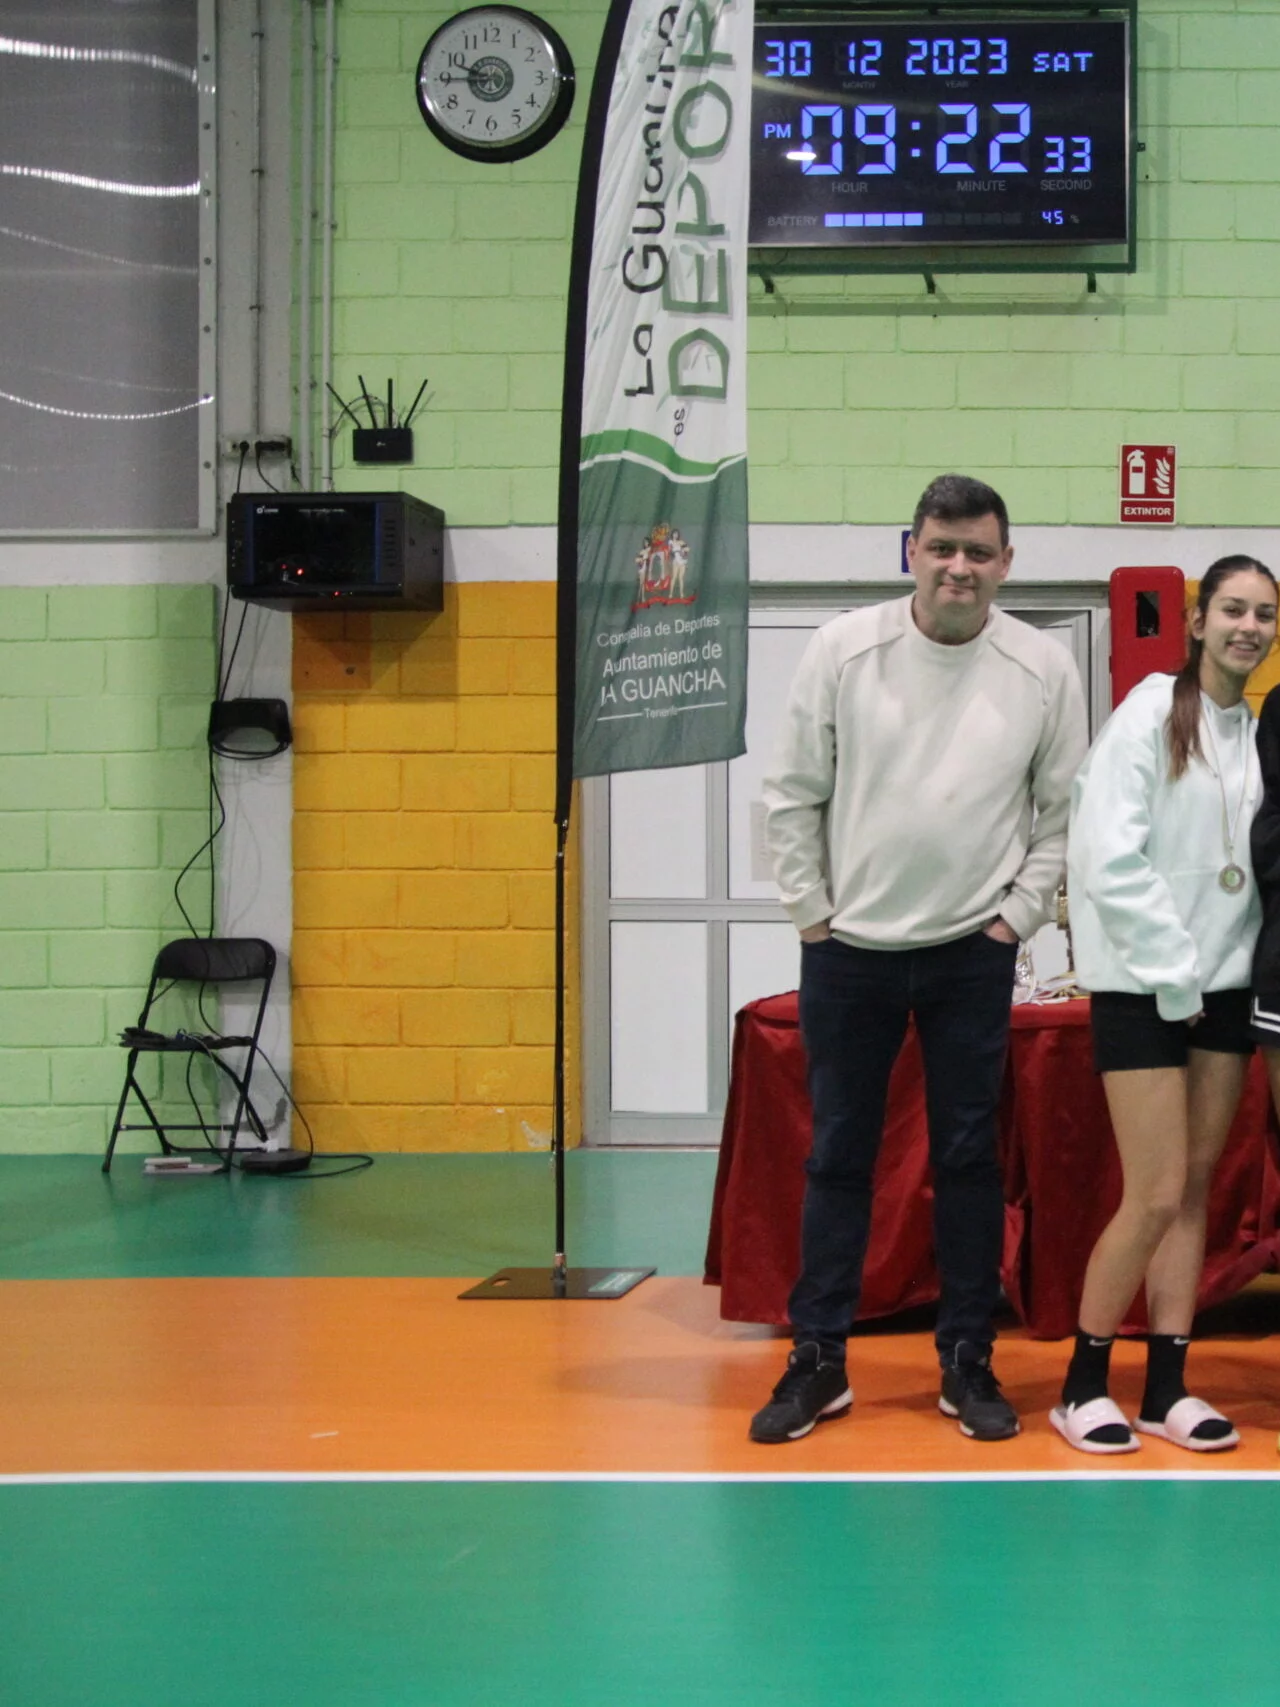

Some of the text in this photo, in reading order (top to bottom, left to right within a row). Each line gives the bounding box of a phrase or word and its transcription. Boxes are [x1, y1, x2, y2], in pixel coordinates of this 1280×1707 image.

[464, 34, 478, 50] 11
[483, 27, 501, 43] 12
[511, 33, 517, 49] 1
[447, 52, 465, 67] 10
[524, 47, 535, 63] 2
[764, 39, 1094, 77] 30 12 2023 SAT
[439, 71, 451, 87] 9
[535, 70, 545, 86] 3
[446, 94, 458, 110] 8
[525, 93, 536, 108] 4
[466, 110, 476, 125] 7
[485, 115, 498, 131] 6
[511, 109, 522, 125] 5
[763, 103, 1092, 176] PM 09:22 33
[831, 179, 1092, 193] HOUR MINUTE SECOND
[767, 215, 819, 227] BATTERY
[1042, 210, 1065, 225] 45
[1123, 506, 1172, 517] EXTINTOR
[655, 622, 671, 635] de
[701, 639, 723, 661] de
[621, 668, 726, 702] GUANCHA
